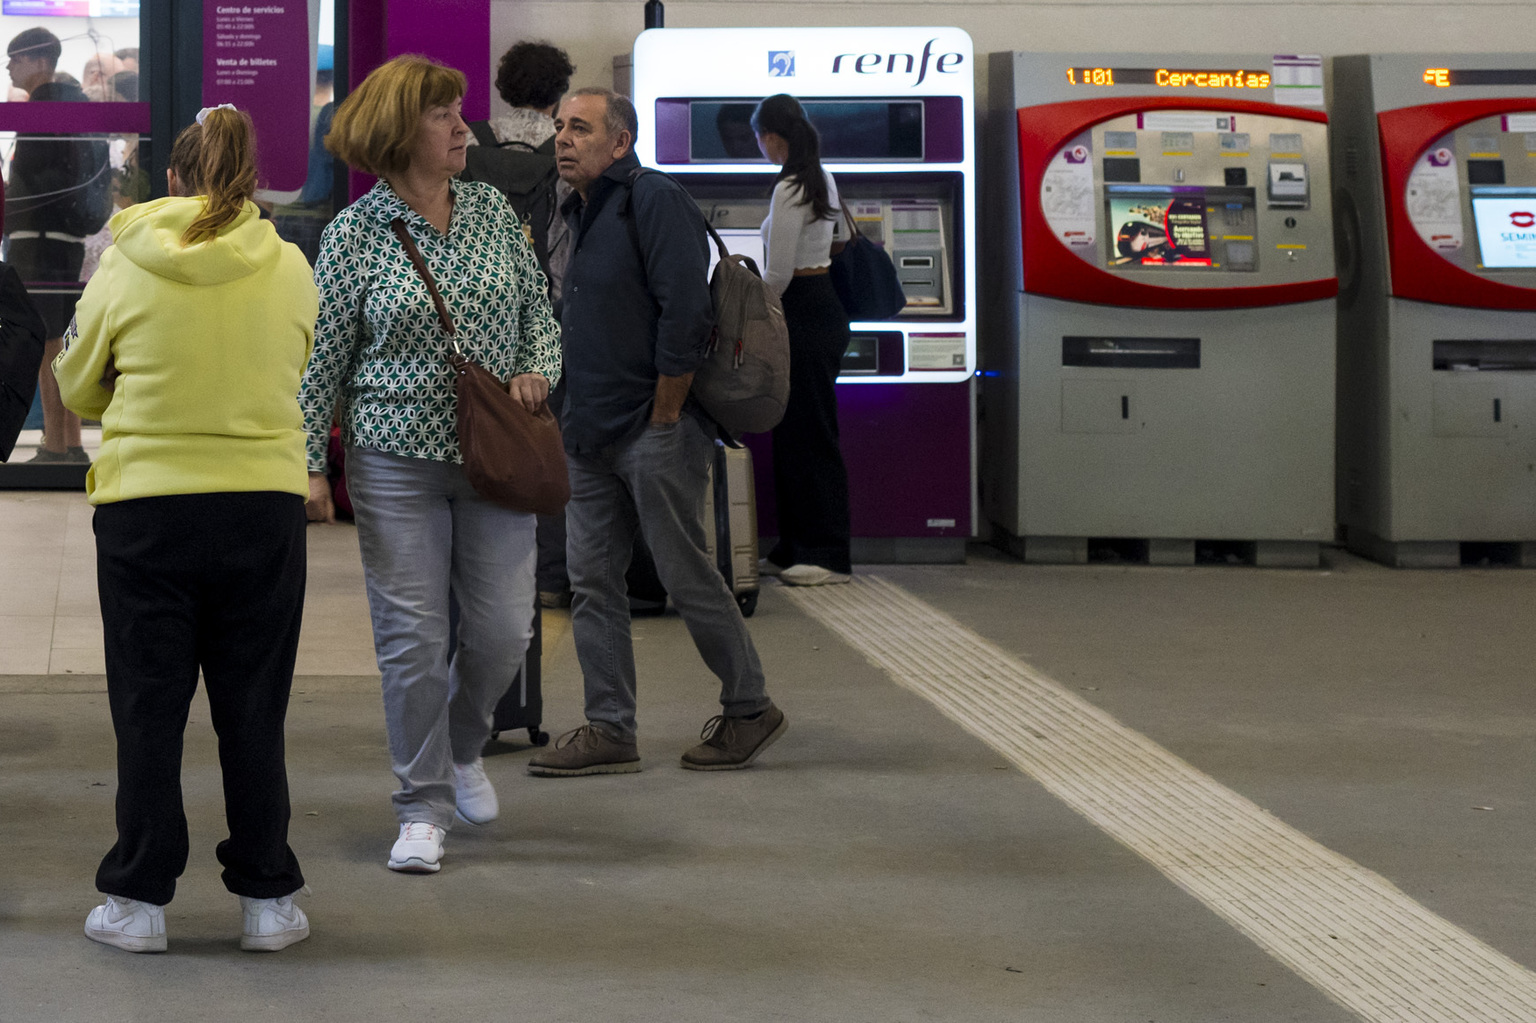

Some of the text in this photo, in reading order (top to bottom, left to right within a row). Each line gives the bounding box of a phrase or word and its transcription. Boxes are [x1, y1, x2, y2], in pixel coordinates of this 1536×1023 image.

[216, 6, 285, 14] Centro de servicios
[216, 57, 278, 66] Venta de billetes
[831, 38, 964, 87] renfe
[1155, 68, 1271, 88] Cercanías
